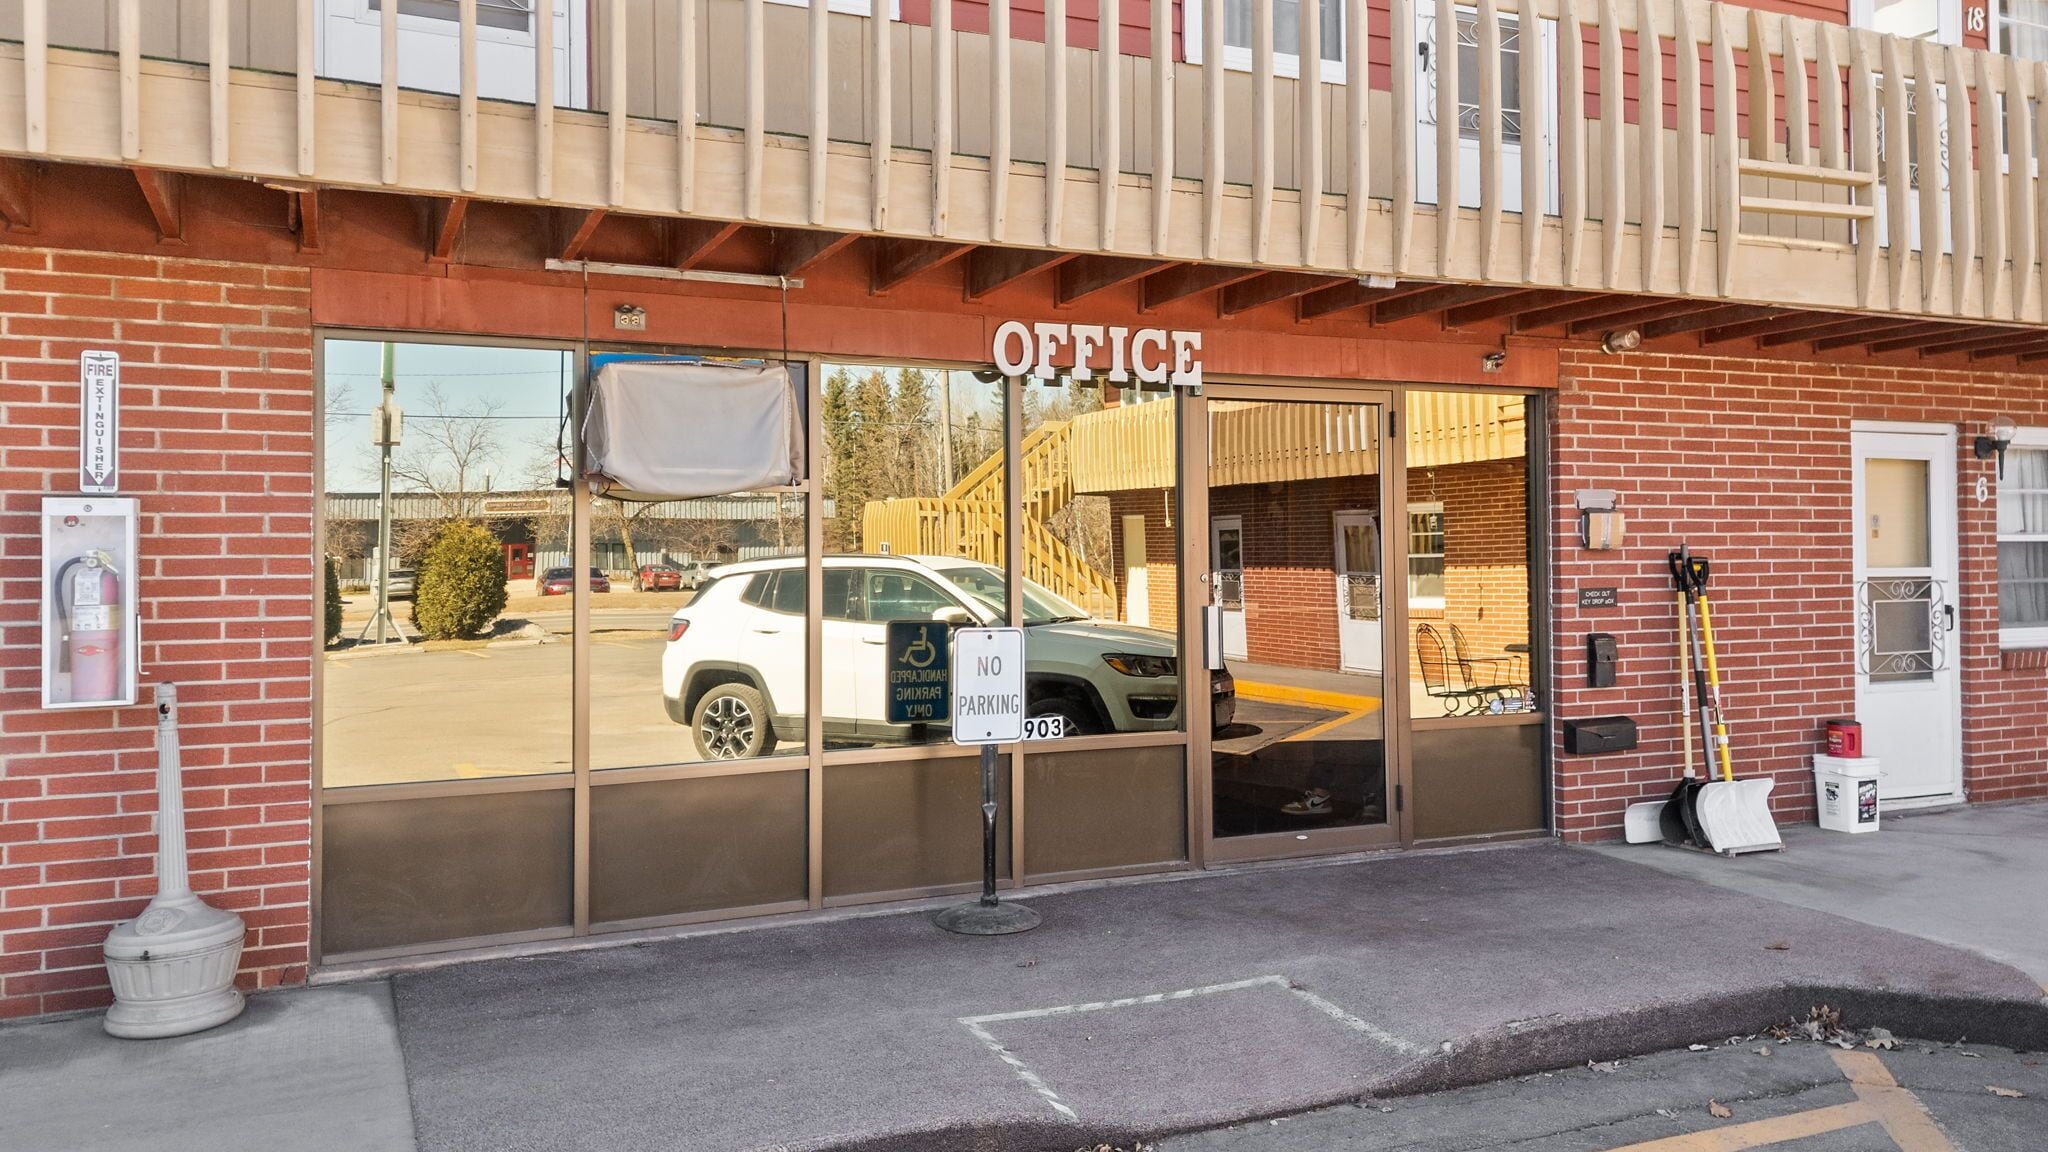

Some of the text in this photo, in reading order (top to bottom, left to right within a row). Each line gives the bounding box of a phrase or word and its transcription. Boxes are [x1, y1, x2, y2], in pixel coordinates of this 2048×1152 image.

[1967, 7, 1984, 32] 18
[993, 320, 1202, 385] OFFICE
[87, 364, 113, 376] FIRE
[95, 379, 104, 479] EXTINGUISHER
[1976, 477, 1988, 502] 6
[977, 656, 1001, 676] NO
[959, 694, 1019, 716] PARKING
[1024, 718, 1062, 739] 903
